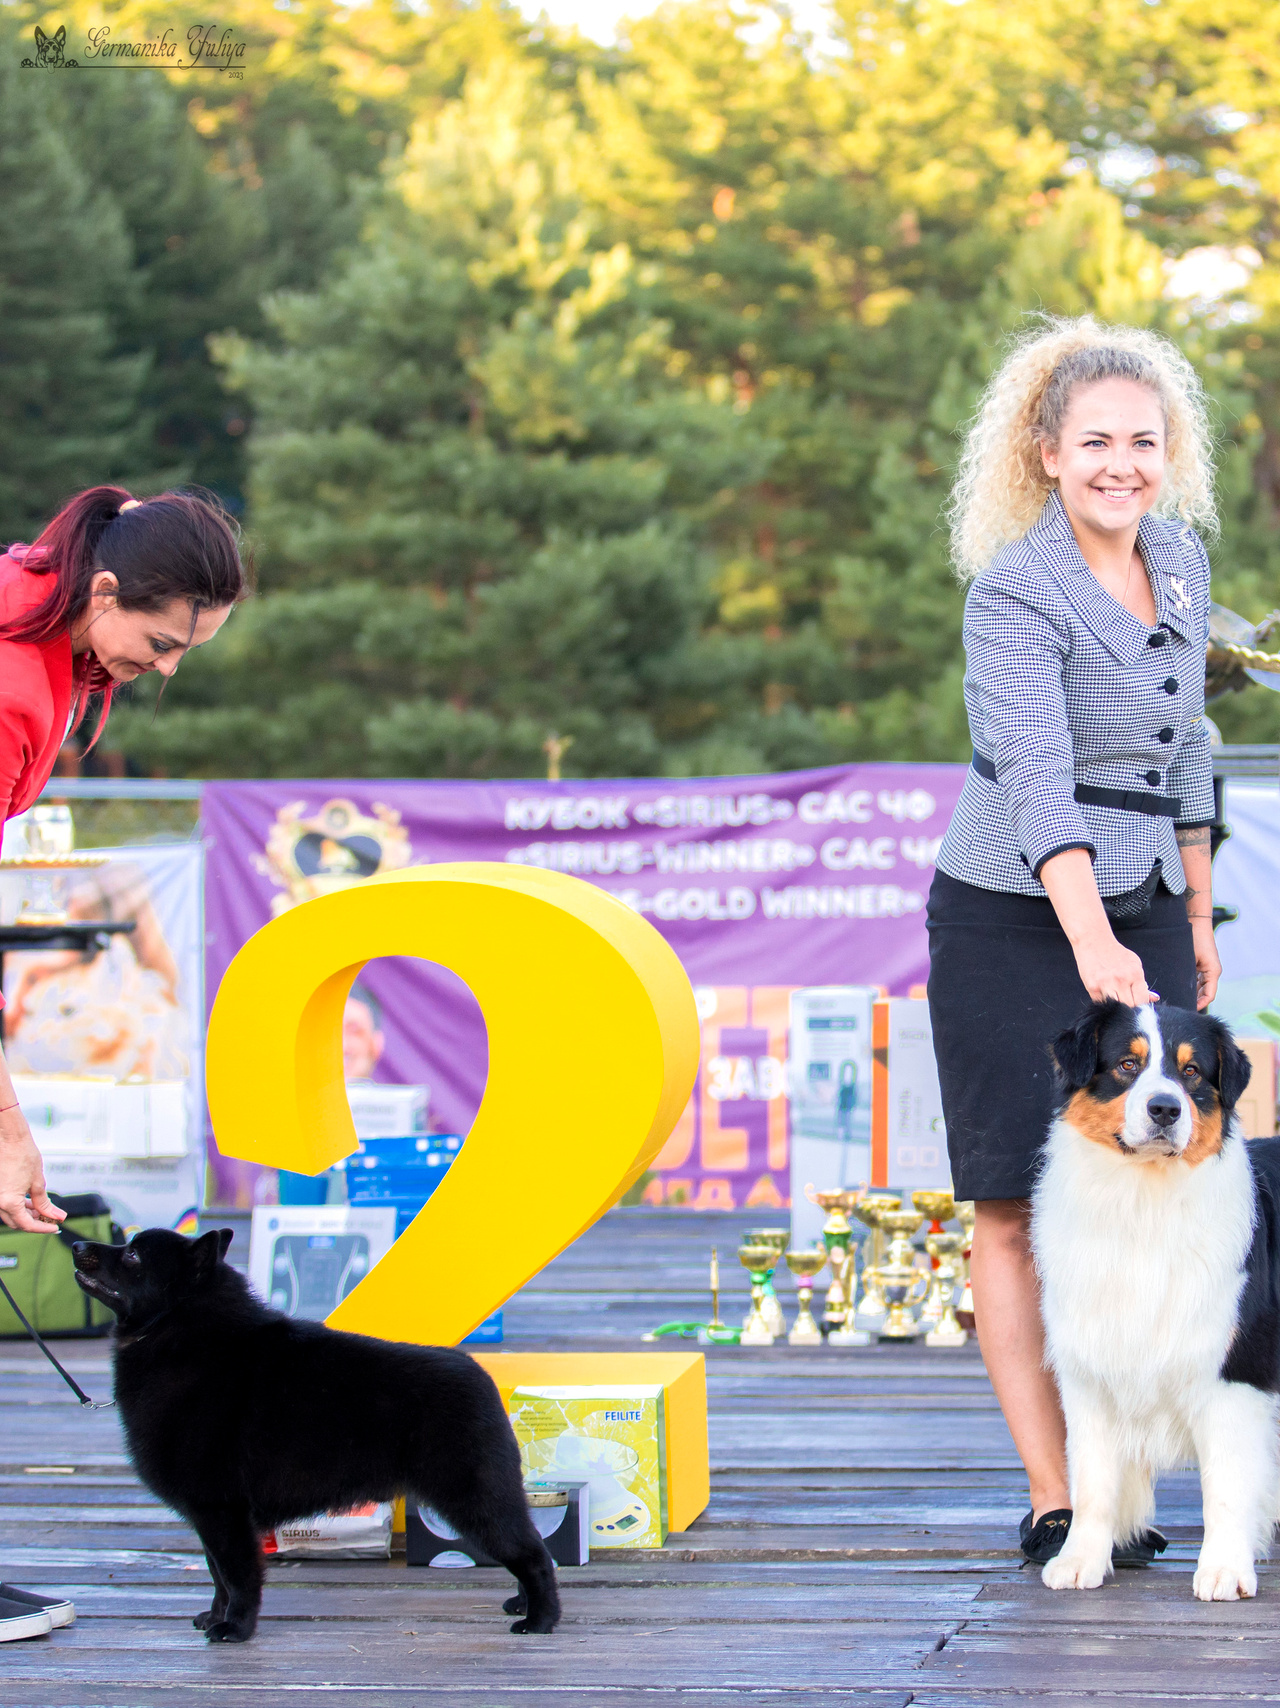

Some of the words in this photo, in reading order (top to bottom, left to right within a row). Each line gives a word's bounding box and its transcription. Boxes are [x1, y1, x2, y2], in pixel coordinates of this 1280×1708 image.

[707, 1055, 792, 1101] ЗАВ
[605, 1411, 642, 1421] FEILITE
[281, 1529, 320, 1538] SIRIUS
